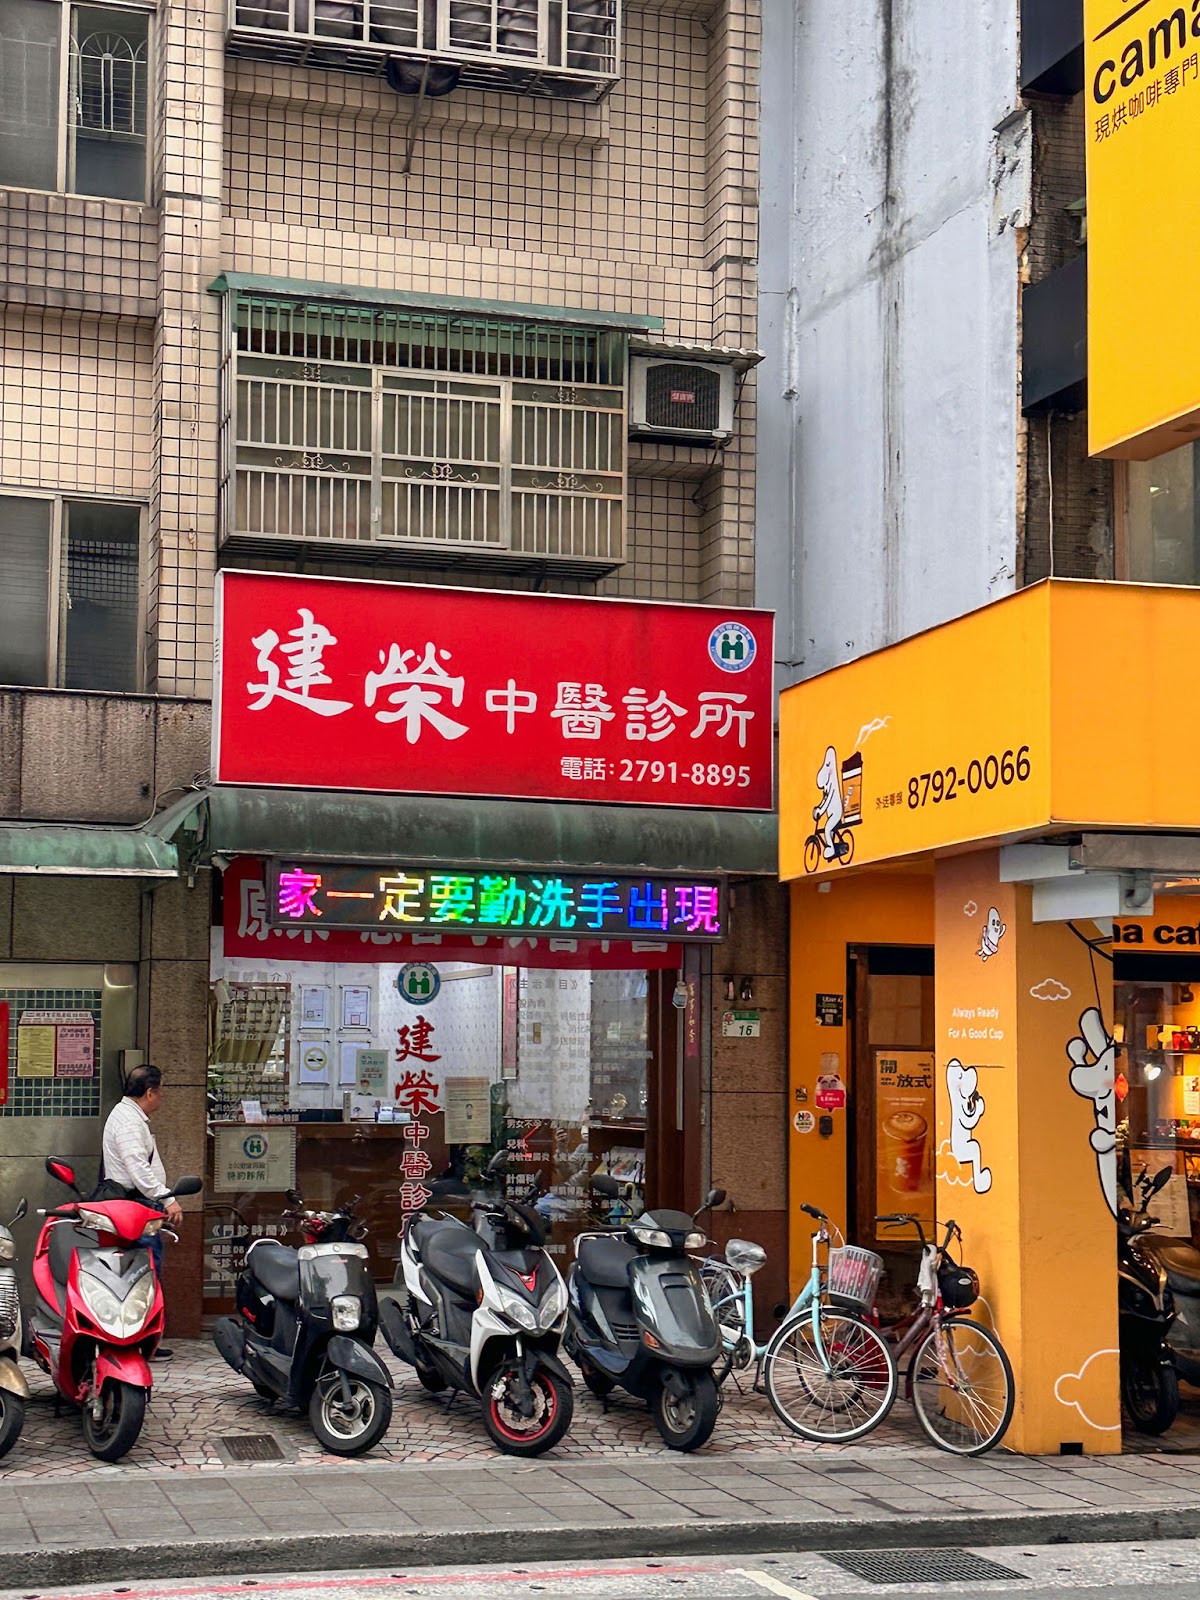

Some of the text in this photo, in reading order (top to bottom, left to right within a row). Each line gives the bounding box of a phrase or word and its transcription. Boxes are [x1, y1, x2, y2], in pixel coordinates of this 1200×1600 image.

[1094, 52, 1199, 143] 現烘咖啡專門
[907, 745, 1031, 810] 8792-0066
[278, 867, 720, 933] 家一定要勤洗手出現
[739, 1024, 753, 1036] 16
[952, 1006, 999, 1020] Always Ready
[948, 1027, 1004, 1041] For A Good Cup
